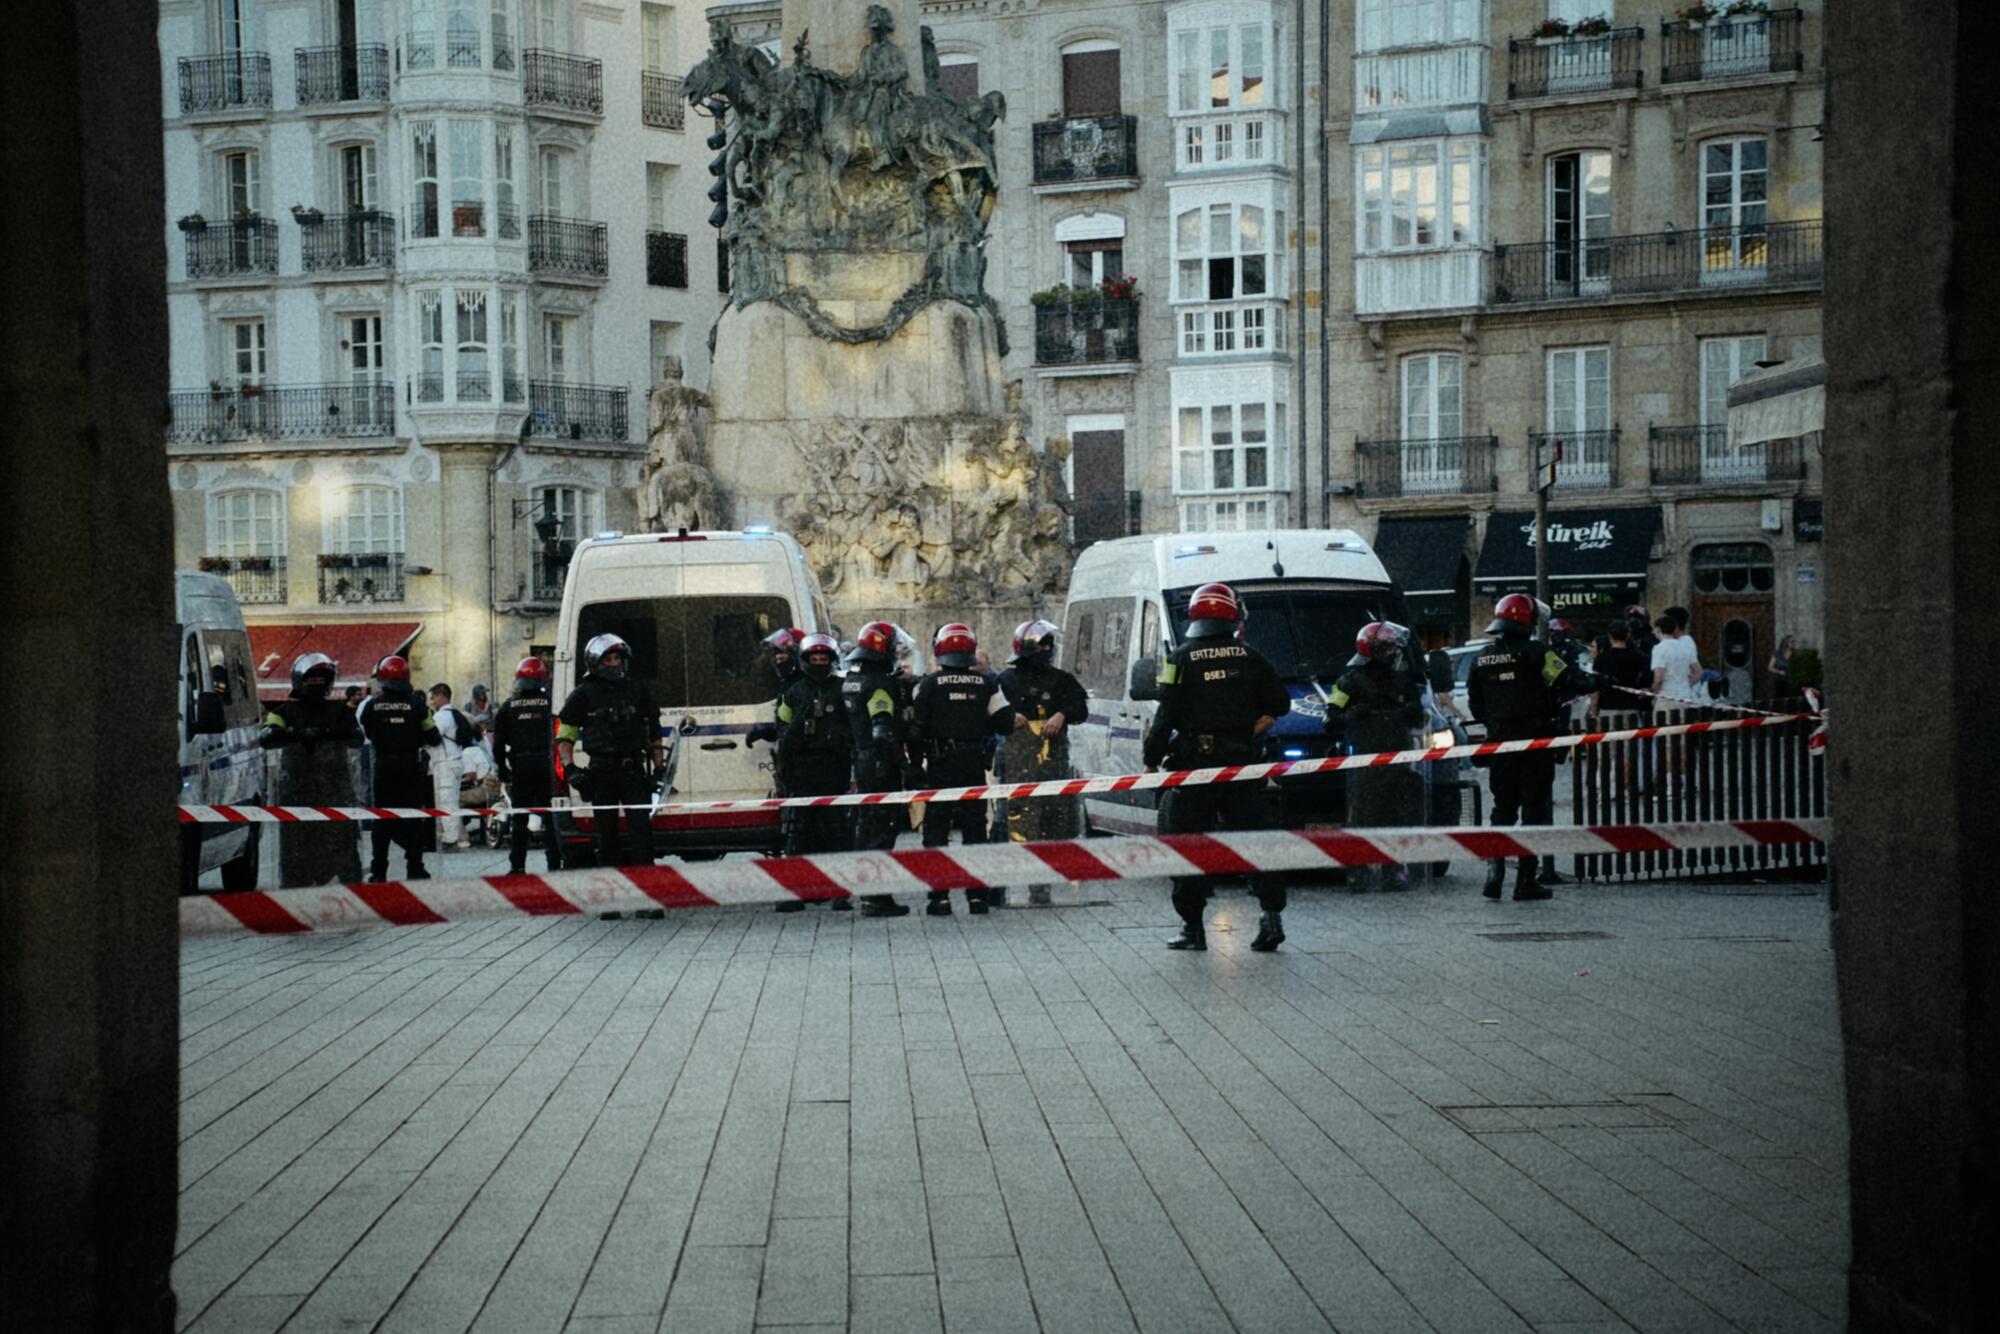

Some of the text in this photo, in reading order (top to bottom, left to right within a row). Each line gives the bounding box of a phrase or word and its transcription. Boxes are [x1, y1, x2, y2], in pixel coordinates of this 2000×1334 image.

[1189, 646, 1248, 661] ERTZAINTZA
[937, 674, 985, 685] ERTZAINTZA
[511, 699, 548, 708] ERTZAINTZA
